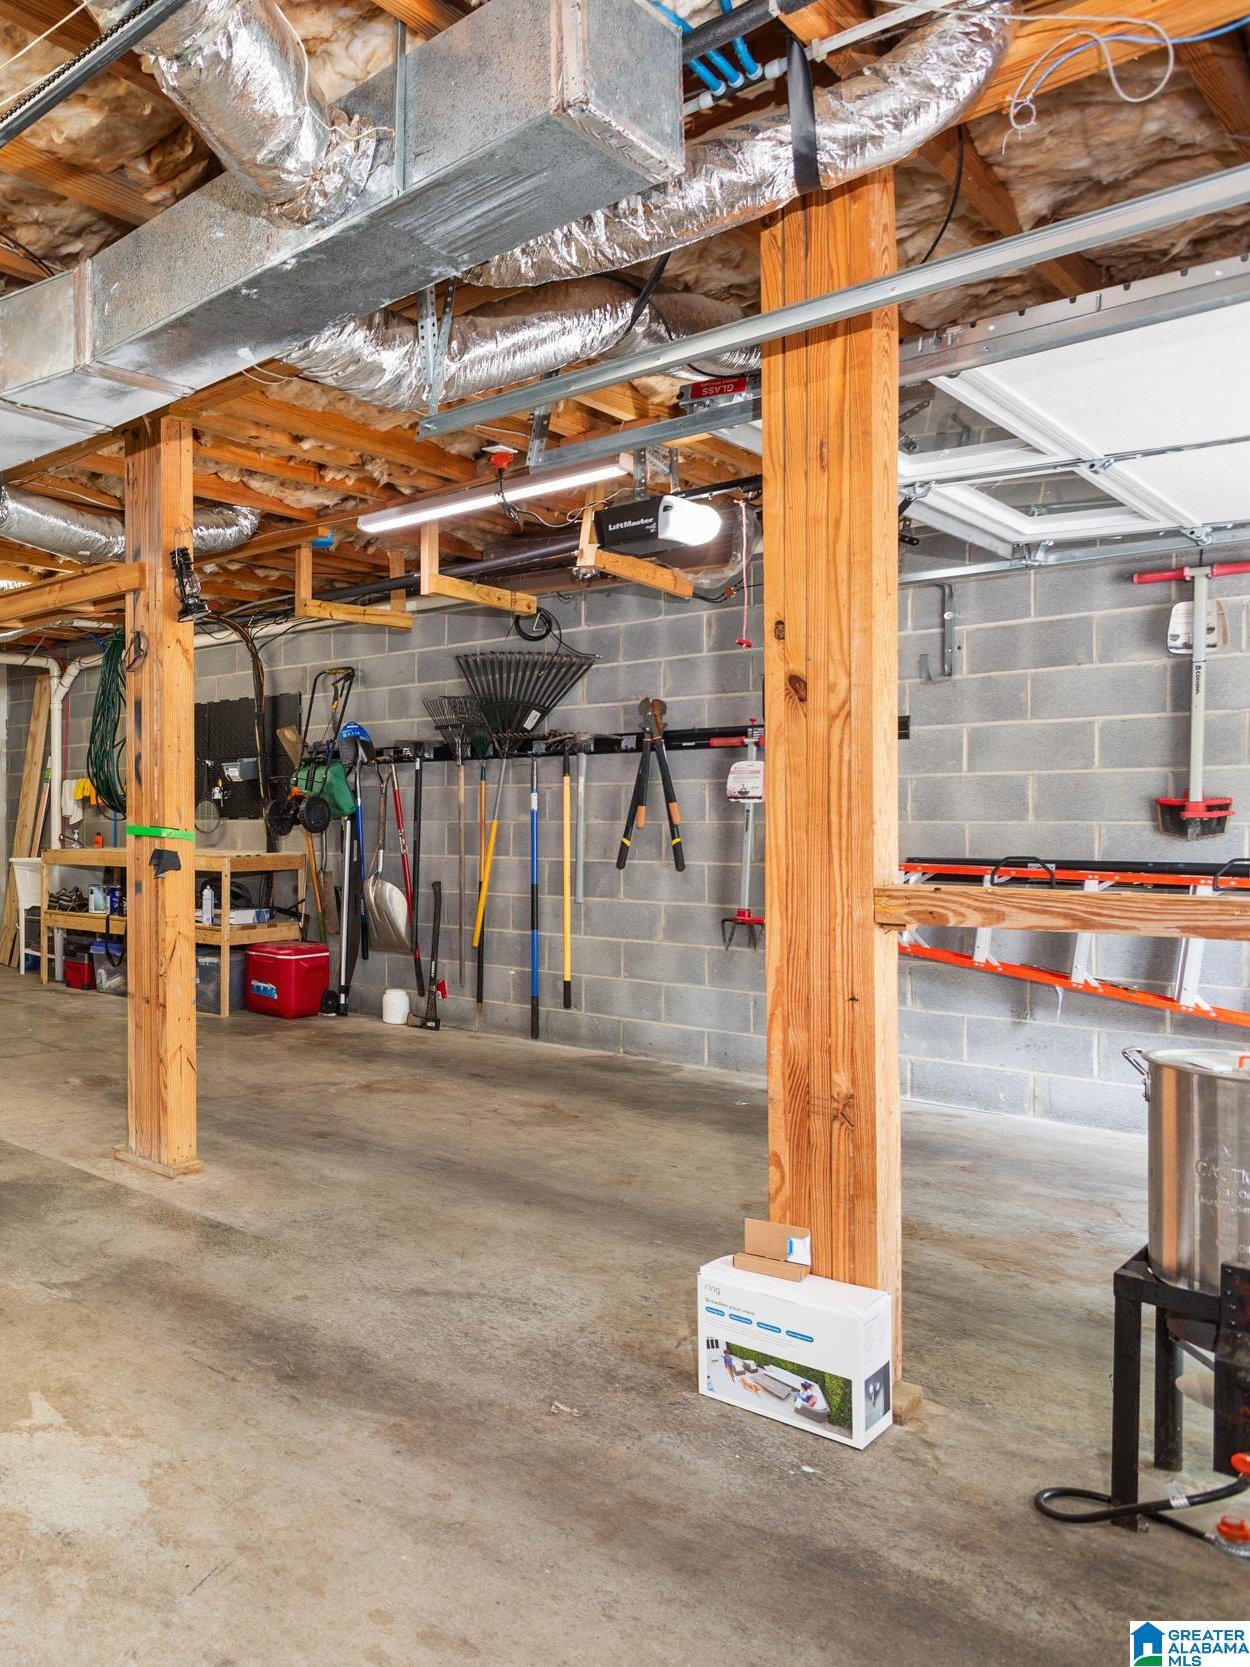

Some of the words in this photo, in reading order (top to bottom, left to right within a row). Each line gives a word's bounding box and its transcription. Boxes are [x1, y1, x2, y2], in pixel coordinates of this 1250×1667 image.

[701, 383, 735, 396] GLASS
[608, 517, 655, 531] LiftMaster
[704, 1283, 721, 1295] ring
